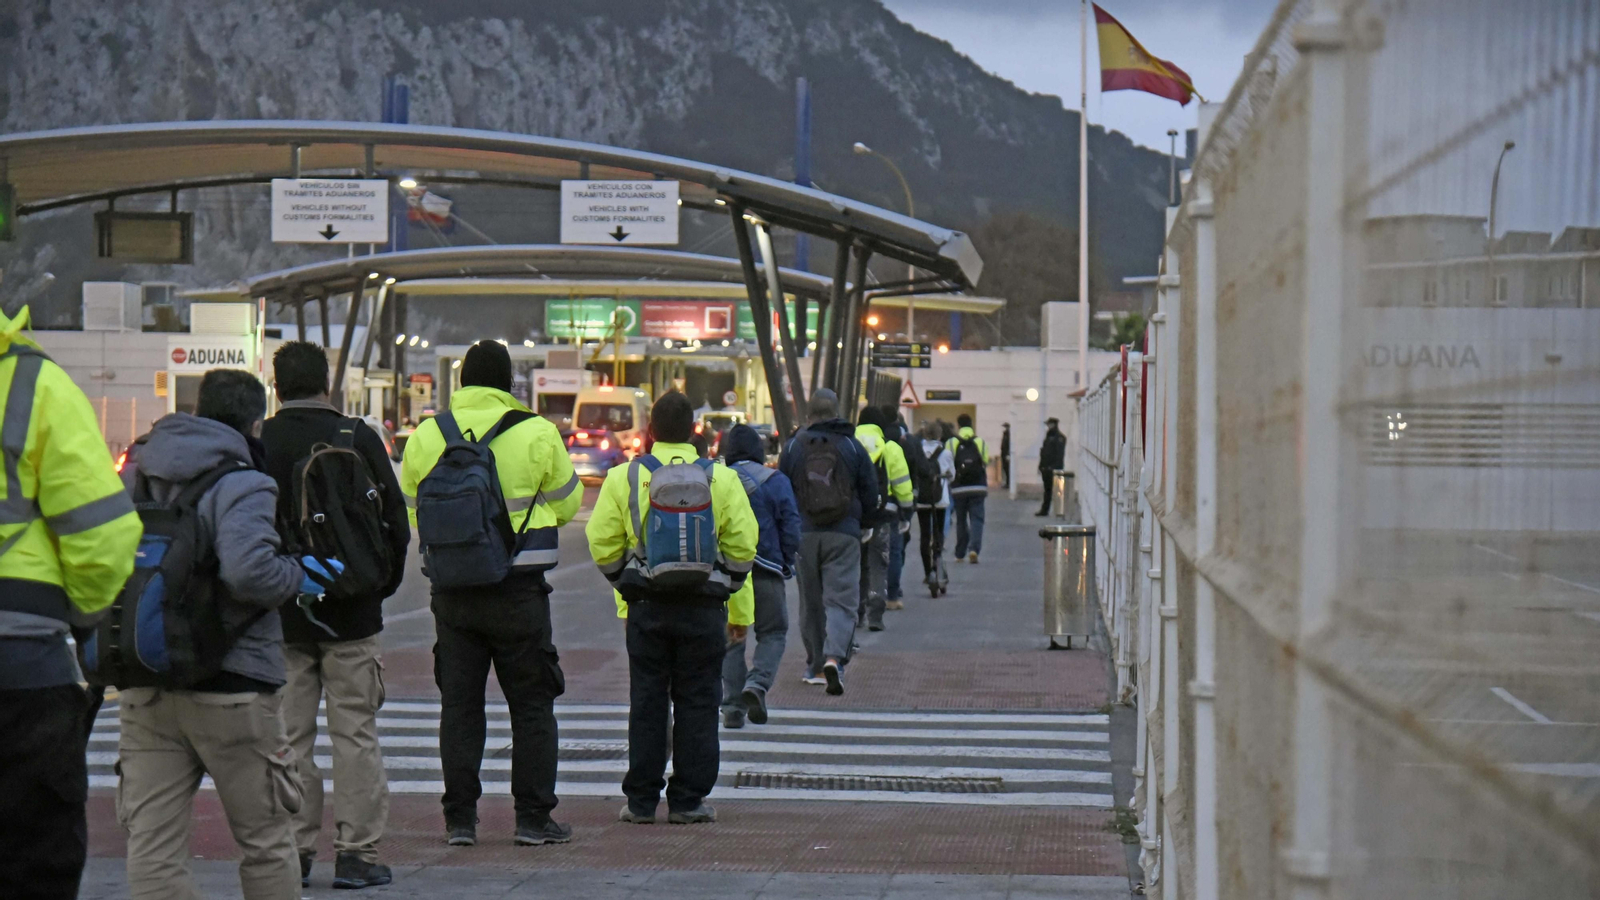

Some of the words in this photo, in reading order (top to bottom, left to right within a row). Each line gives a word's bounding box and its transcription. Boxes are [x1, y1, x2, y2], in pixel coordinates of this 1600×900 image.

[347, 181, 361, 189] SIN
[325, 189, 376, 197] ADUANEROS
[615, 191, 666, 199] ADUANEROS
[283, 213, 321, 221] CUSTOMS
[322, 213, 375, 221] FORMALITIES
[188, 349, 245, 364] ADUANA
